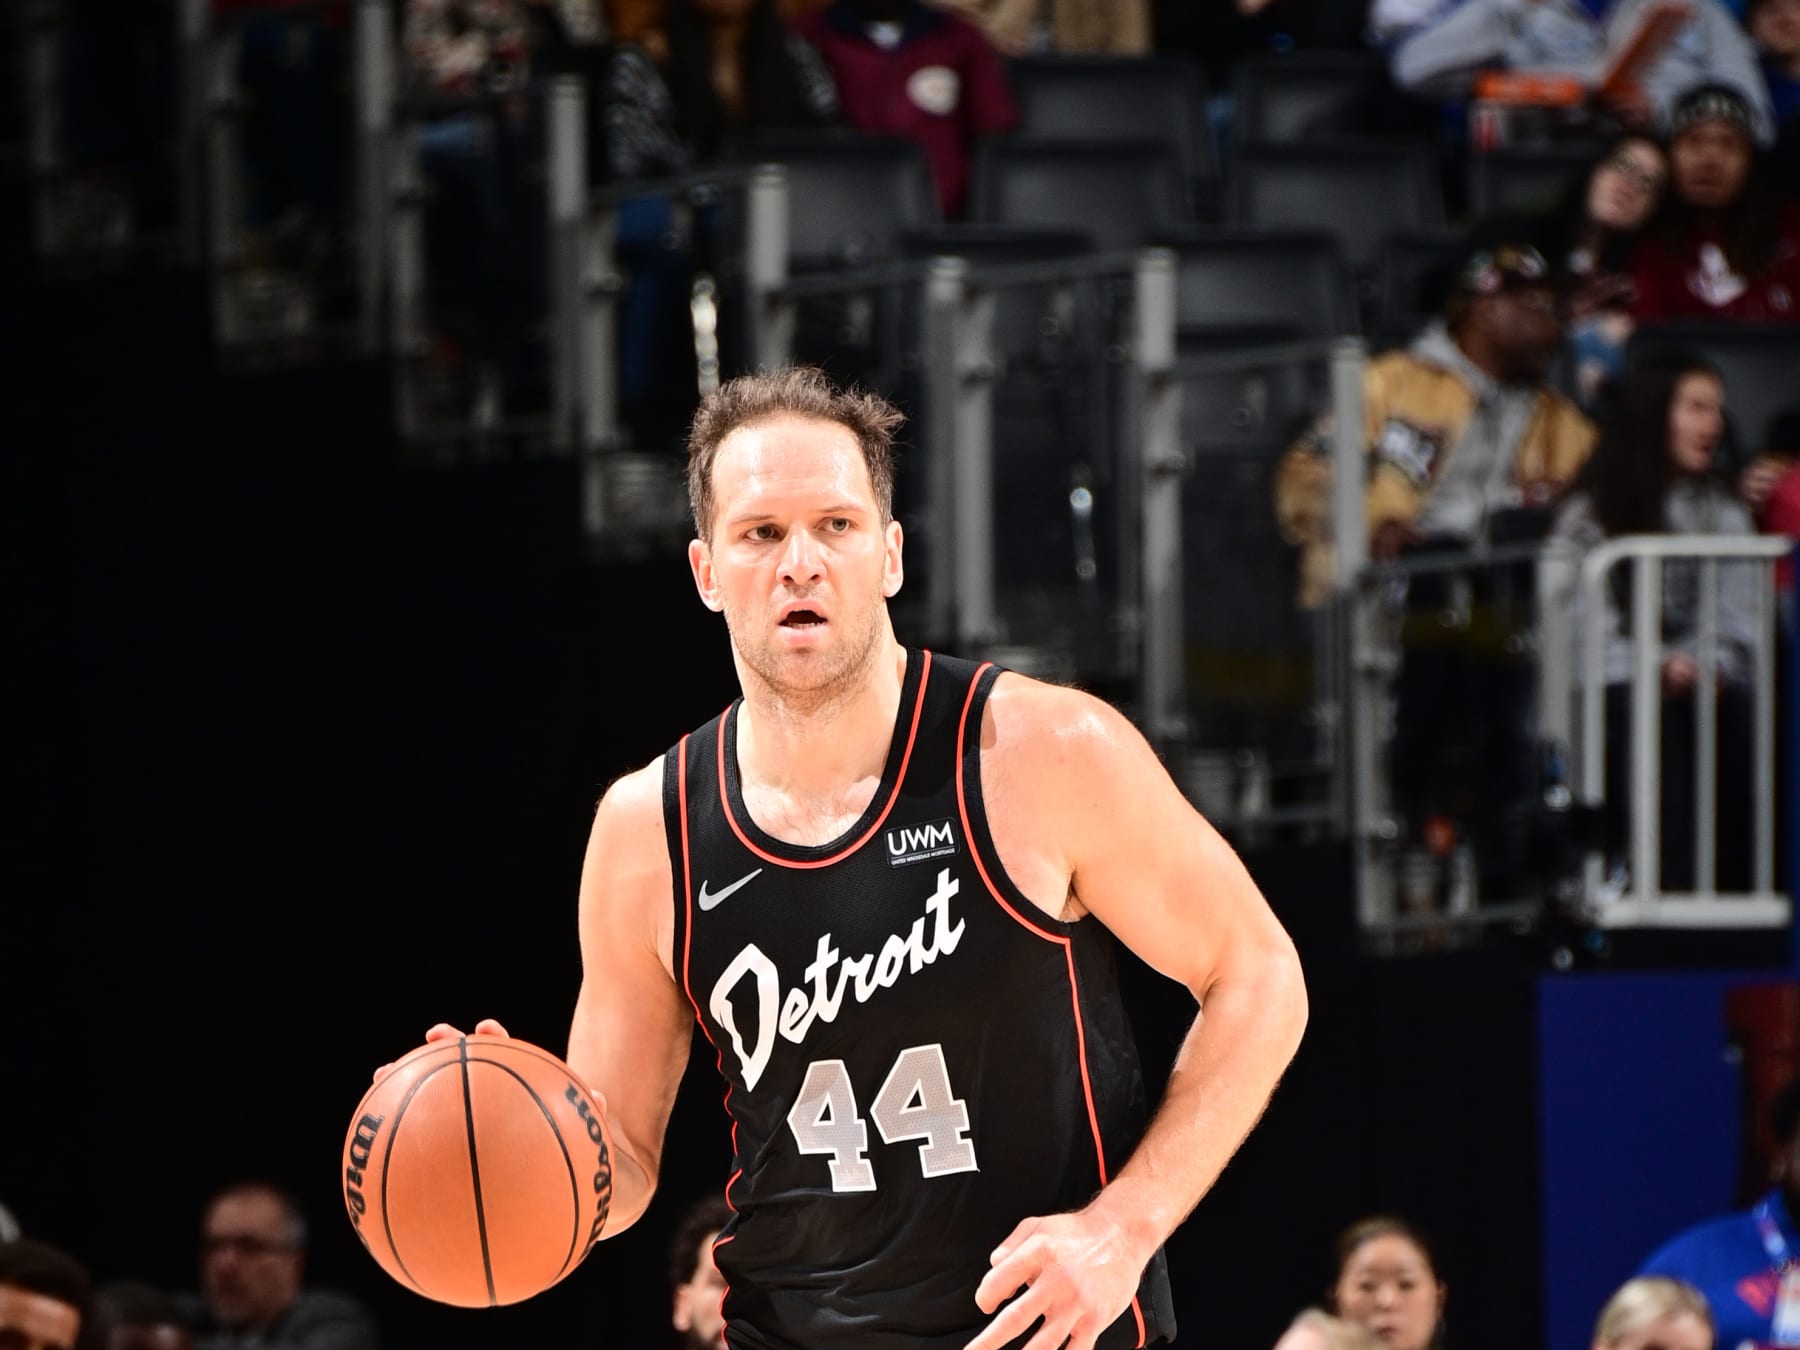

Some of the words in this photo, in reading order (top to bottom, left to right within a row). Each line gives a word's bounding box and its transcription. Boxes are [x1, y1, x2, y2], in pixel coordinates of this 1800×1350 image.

[887, 821, 954, 856] UWM
[709, 867, 966, 1093] Detroit
[786, 1043, 980, 1193] 44
